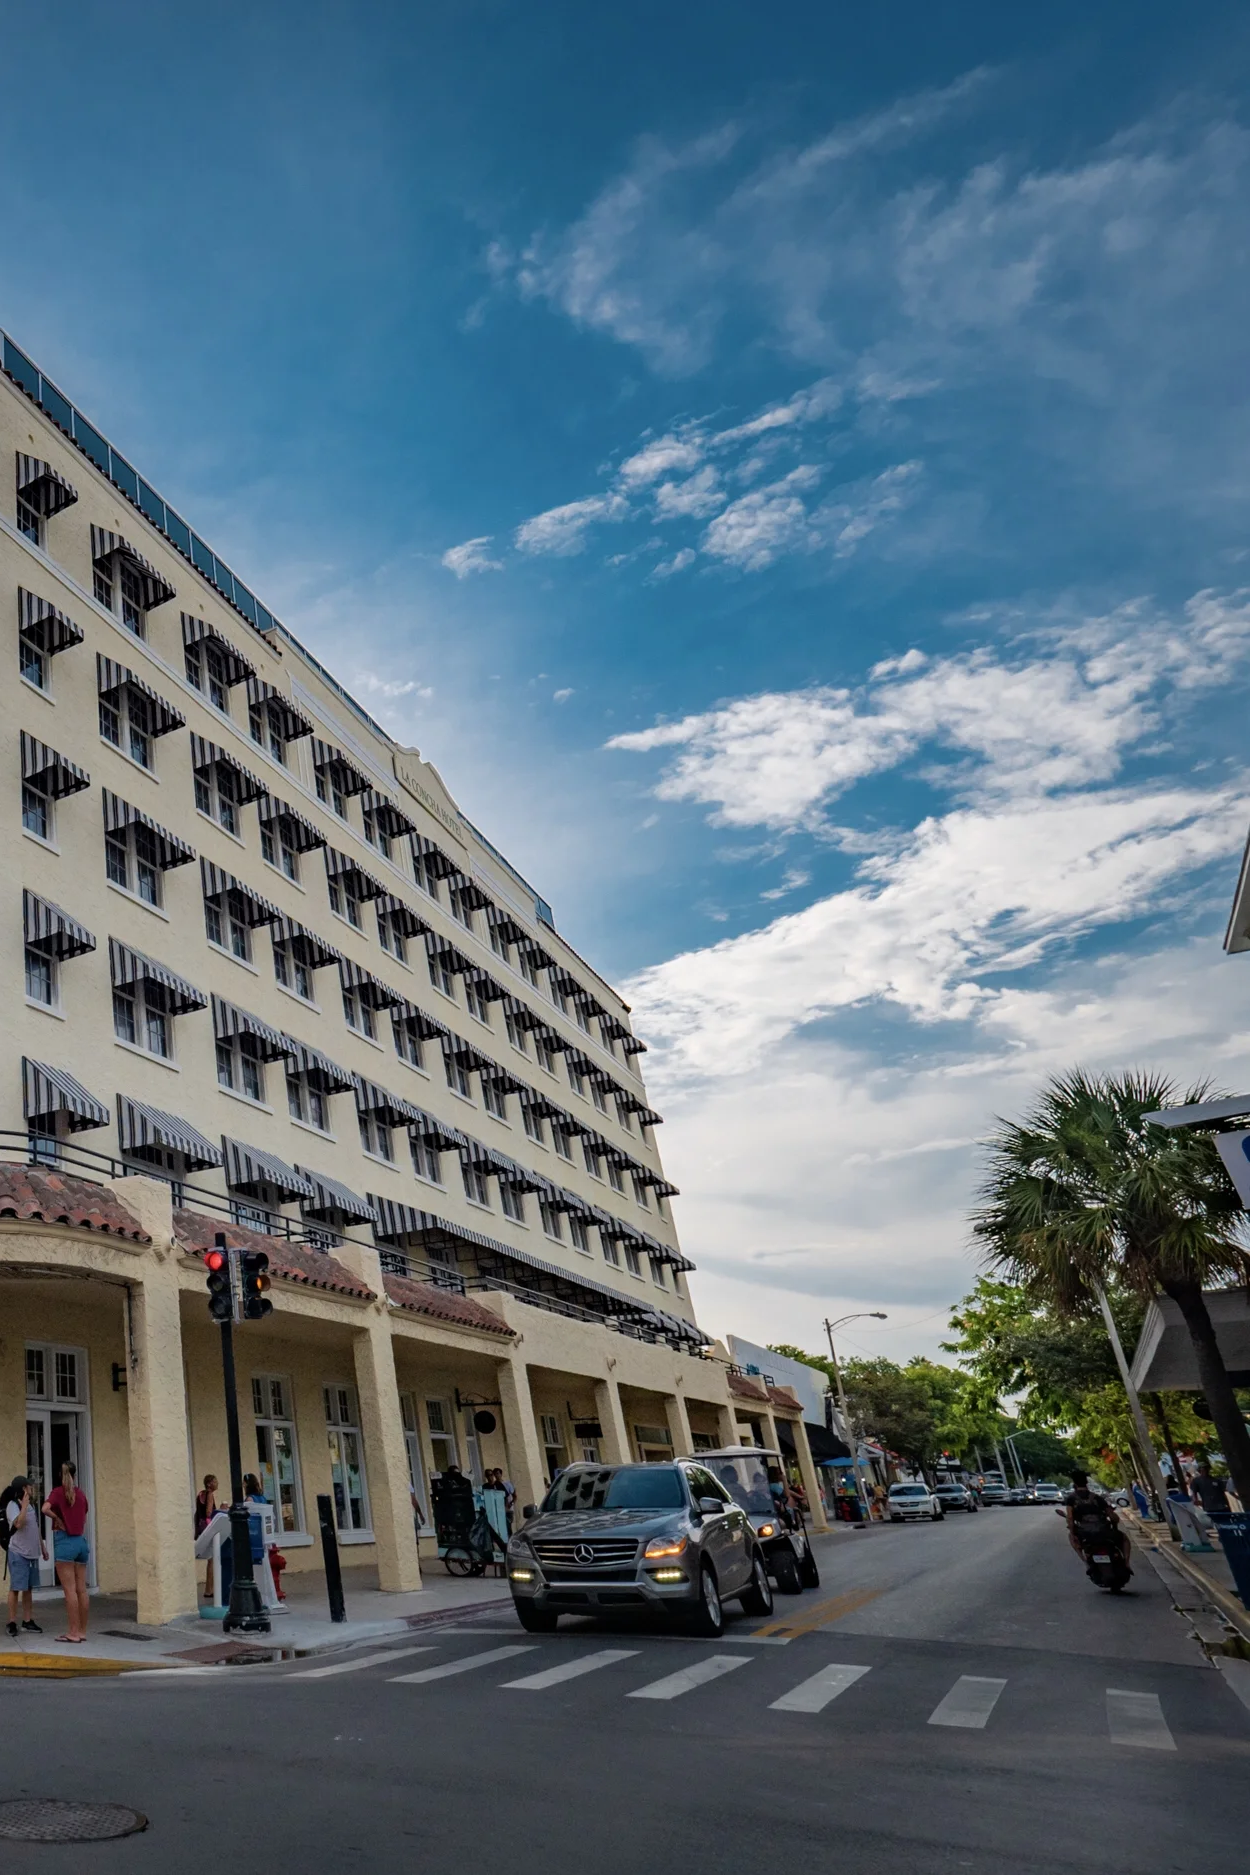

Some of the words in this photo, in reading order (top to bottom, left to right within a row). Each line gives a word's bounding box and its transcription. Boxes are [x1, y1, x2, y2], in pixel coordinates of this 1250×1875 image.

[400, 766, 411, 787] LA
[411, 778, 442, 817] CONCHA
[441, 808, 464, 840] HOTEL
